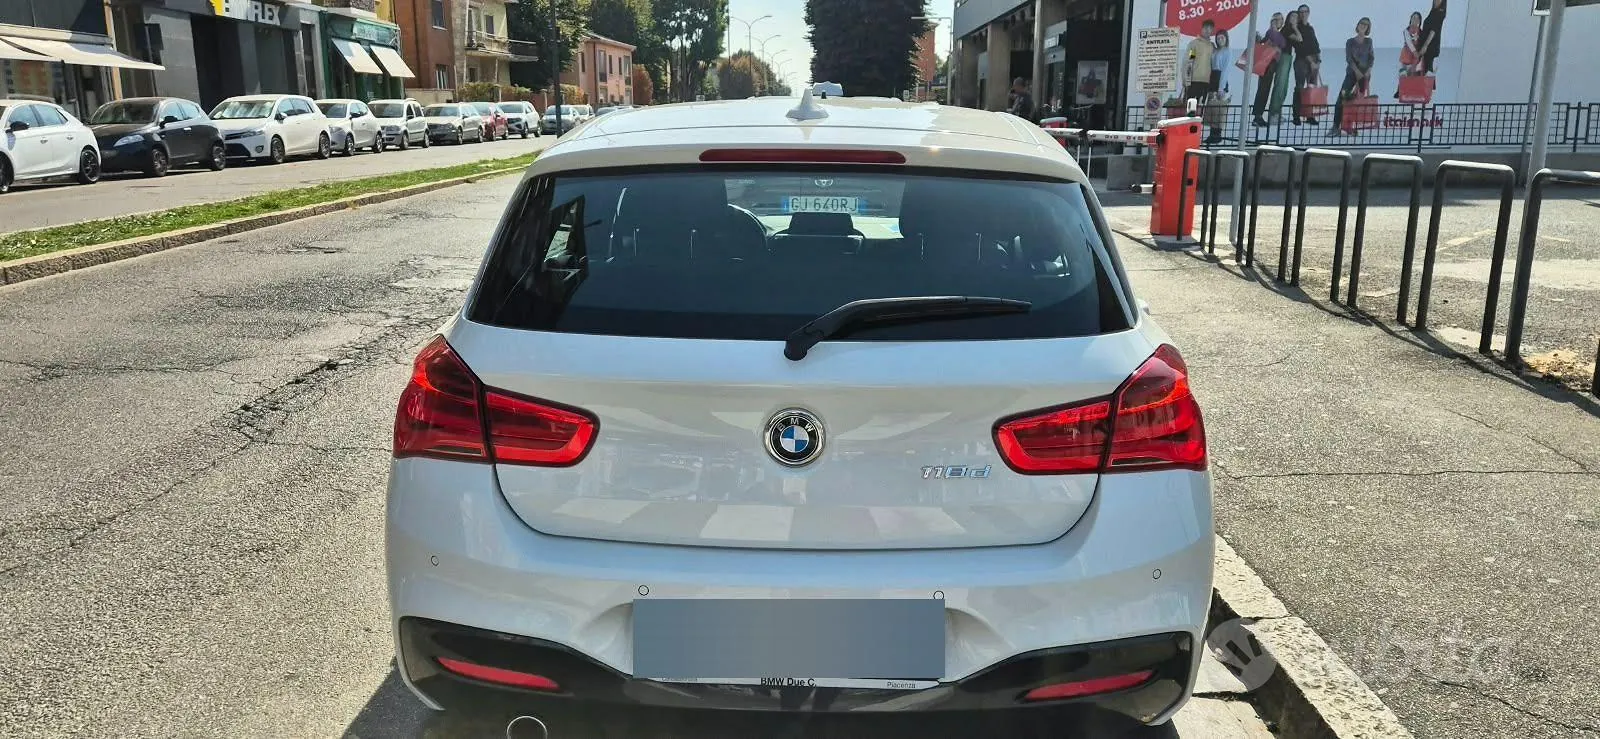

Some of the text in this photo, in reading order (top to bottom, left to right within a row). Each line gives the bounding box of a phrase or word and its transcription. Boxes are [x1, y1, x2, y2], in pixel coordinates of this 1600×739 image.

[1178, 6, 1205, 20] 8.30
[1216, 0, 1249, 12] 20.00
[776, 417, 814, 432] BMW
[920, 464, 992, 480] 118d
[760, 677, 784, 686] BMW
[787, 677, 805, 686] Due
[887, 681, 916, 689] Piacenza
